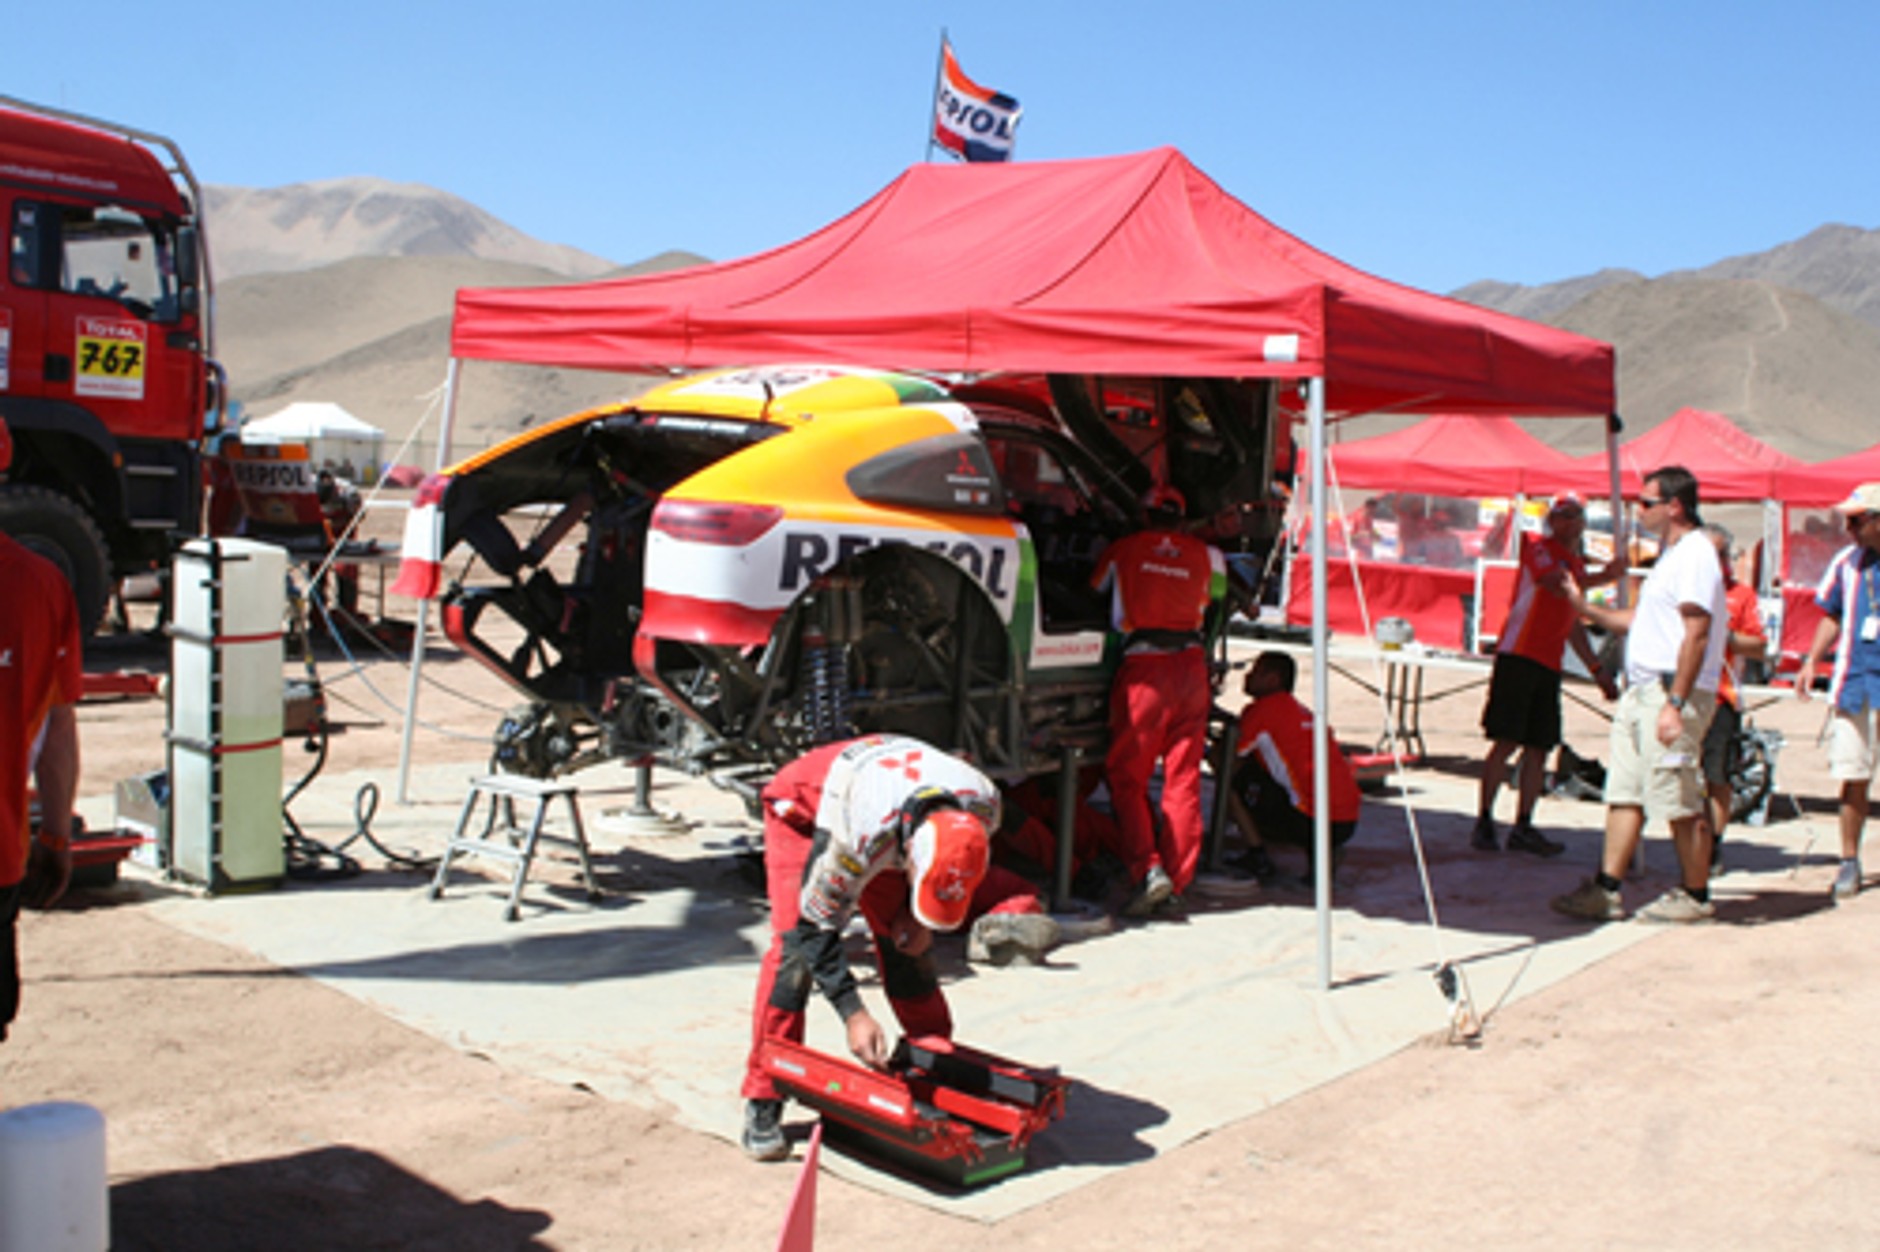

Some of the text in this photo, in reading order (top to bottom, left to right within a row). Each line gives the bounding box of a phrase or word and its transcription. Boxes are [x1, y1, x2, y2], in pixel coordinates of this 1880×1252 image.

[941, 89, 1010, 140] PSOL
[81, 341, 141, 375] 767
[779, 534, 1007, 599] ROL
